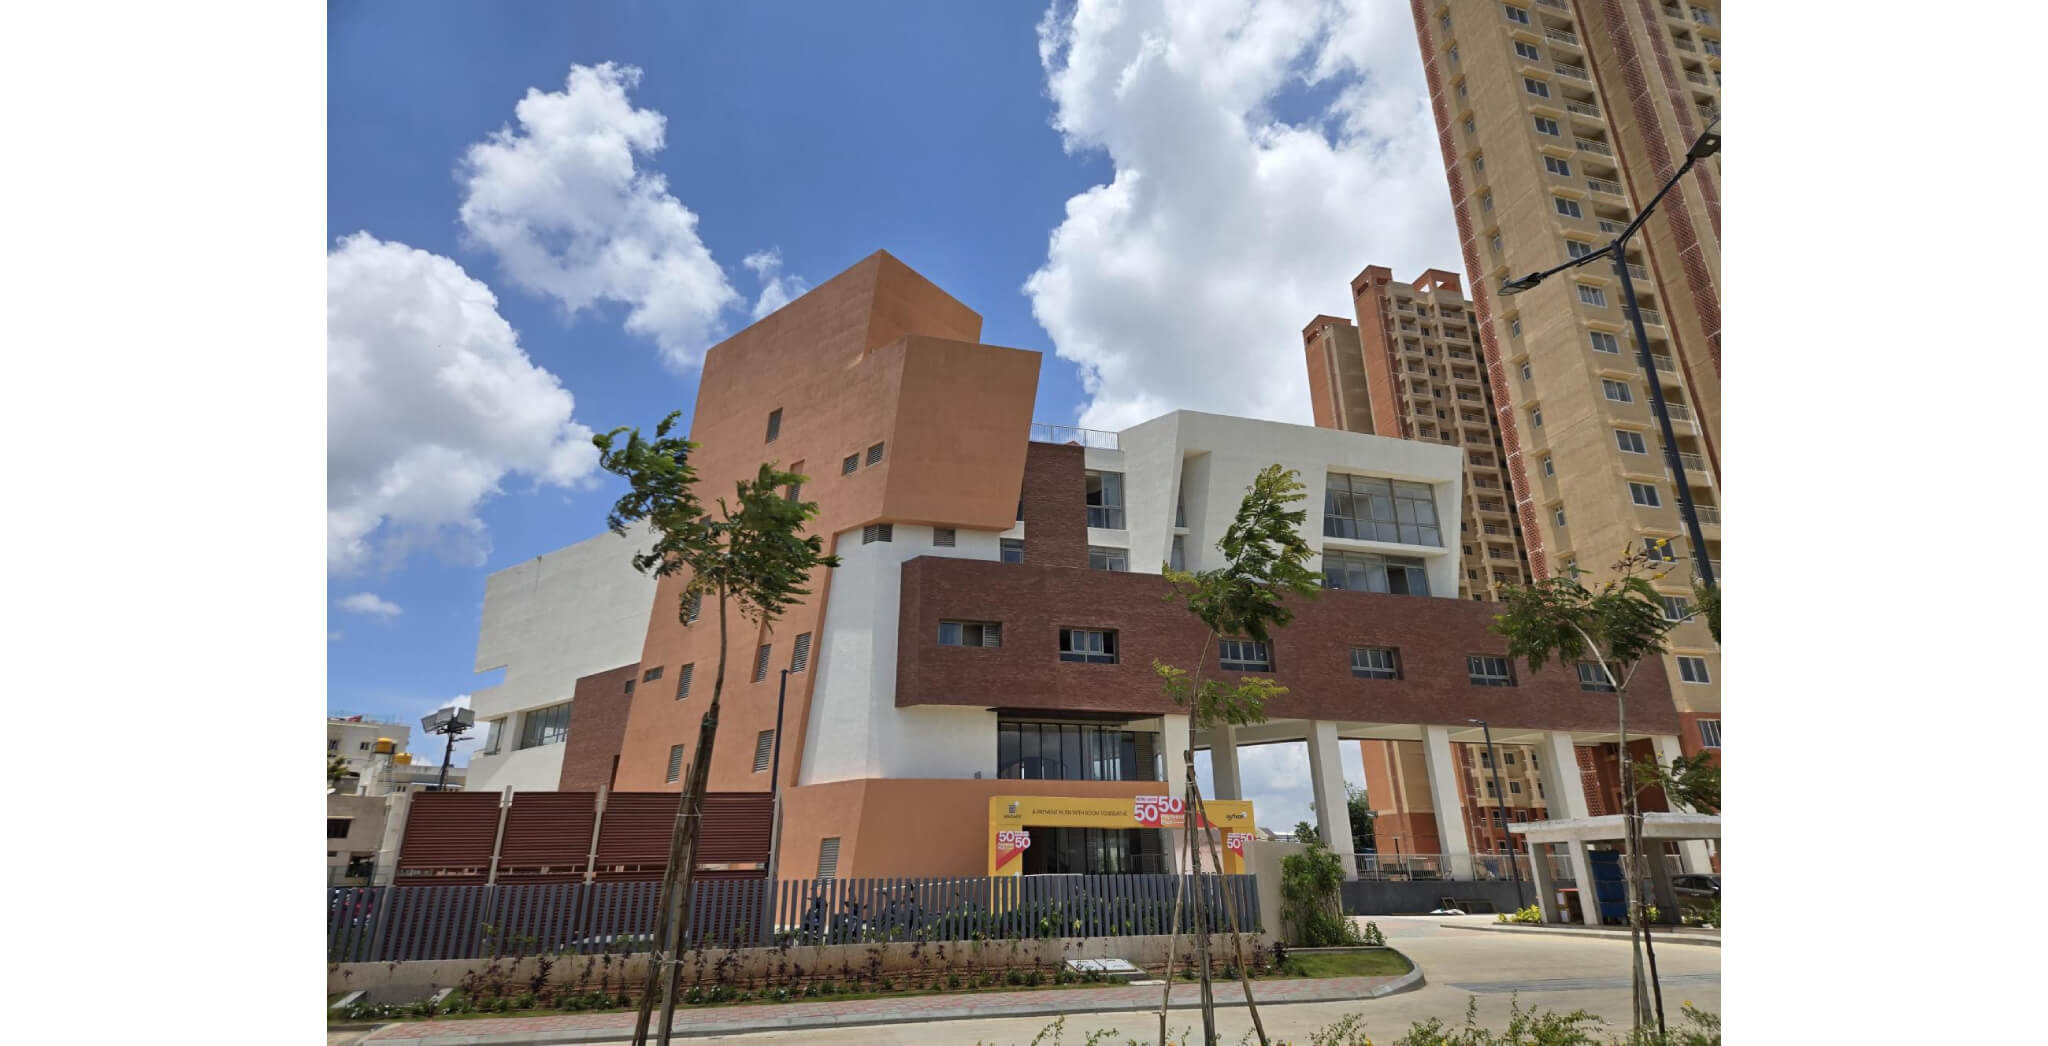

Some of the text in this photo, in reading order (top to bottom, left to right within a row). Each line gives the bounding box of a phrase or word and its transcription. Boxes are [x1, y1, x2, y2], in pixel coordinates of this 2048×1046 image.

[1135, 804, 1158, 822] 50
[1159, 796, 1182, 813] 50
[999, 831, 1015, 842] 50
[1015, 836, 1031, 849] 50
[1227, 838, 1241, 849] 50
